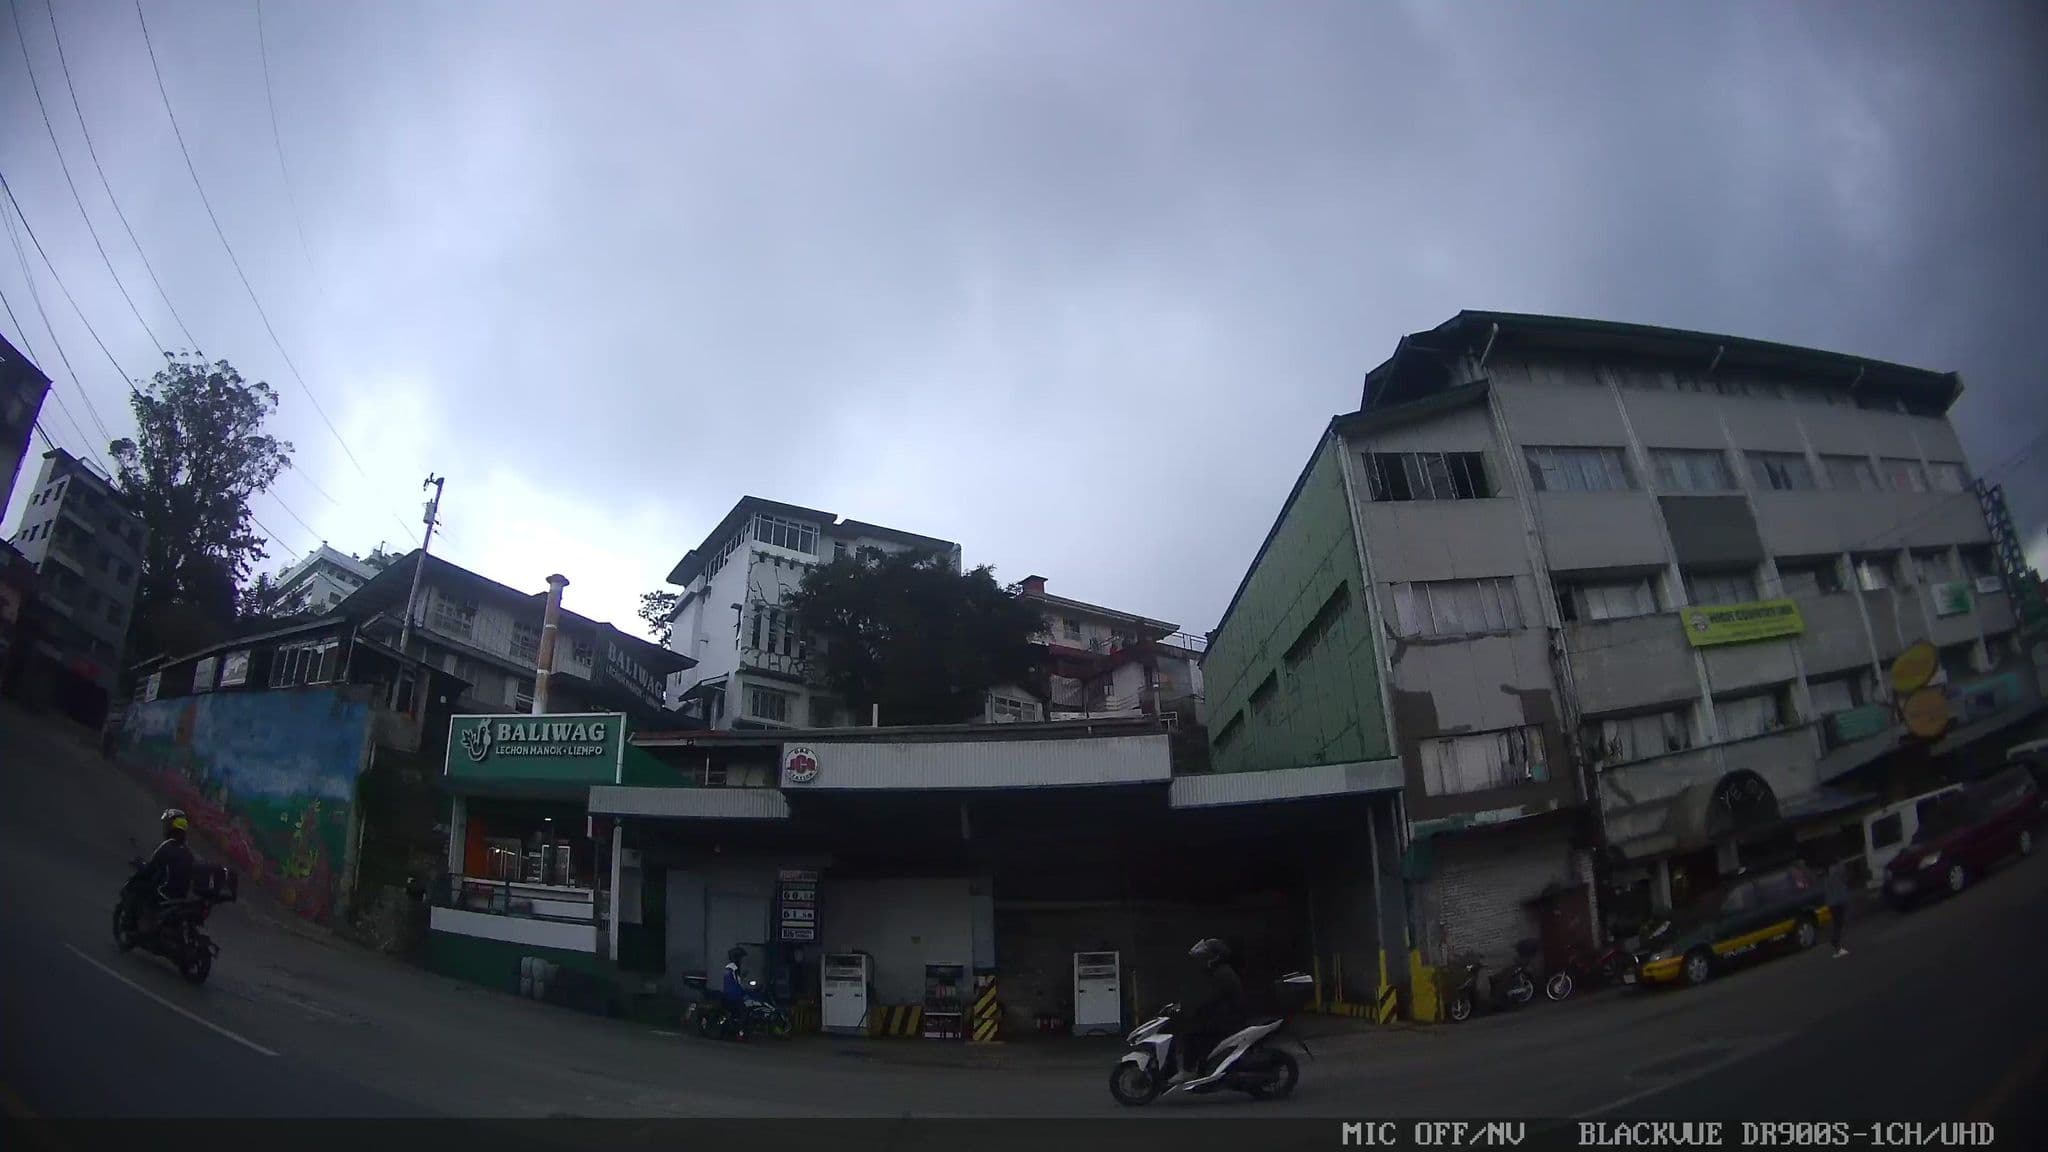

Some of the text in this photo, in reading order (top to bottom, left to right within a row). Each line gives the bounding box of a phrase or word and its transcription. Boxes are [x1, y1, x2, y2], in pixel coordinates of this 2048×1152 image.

[496, 723, 605, 742] BALIWAG
[496, 745, 604, 756] LECHON MANOK LIEMPO
